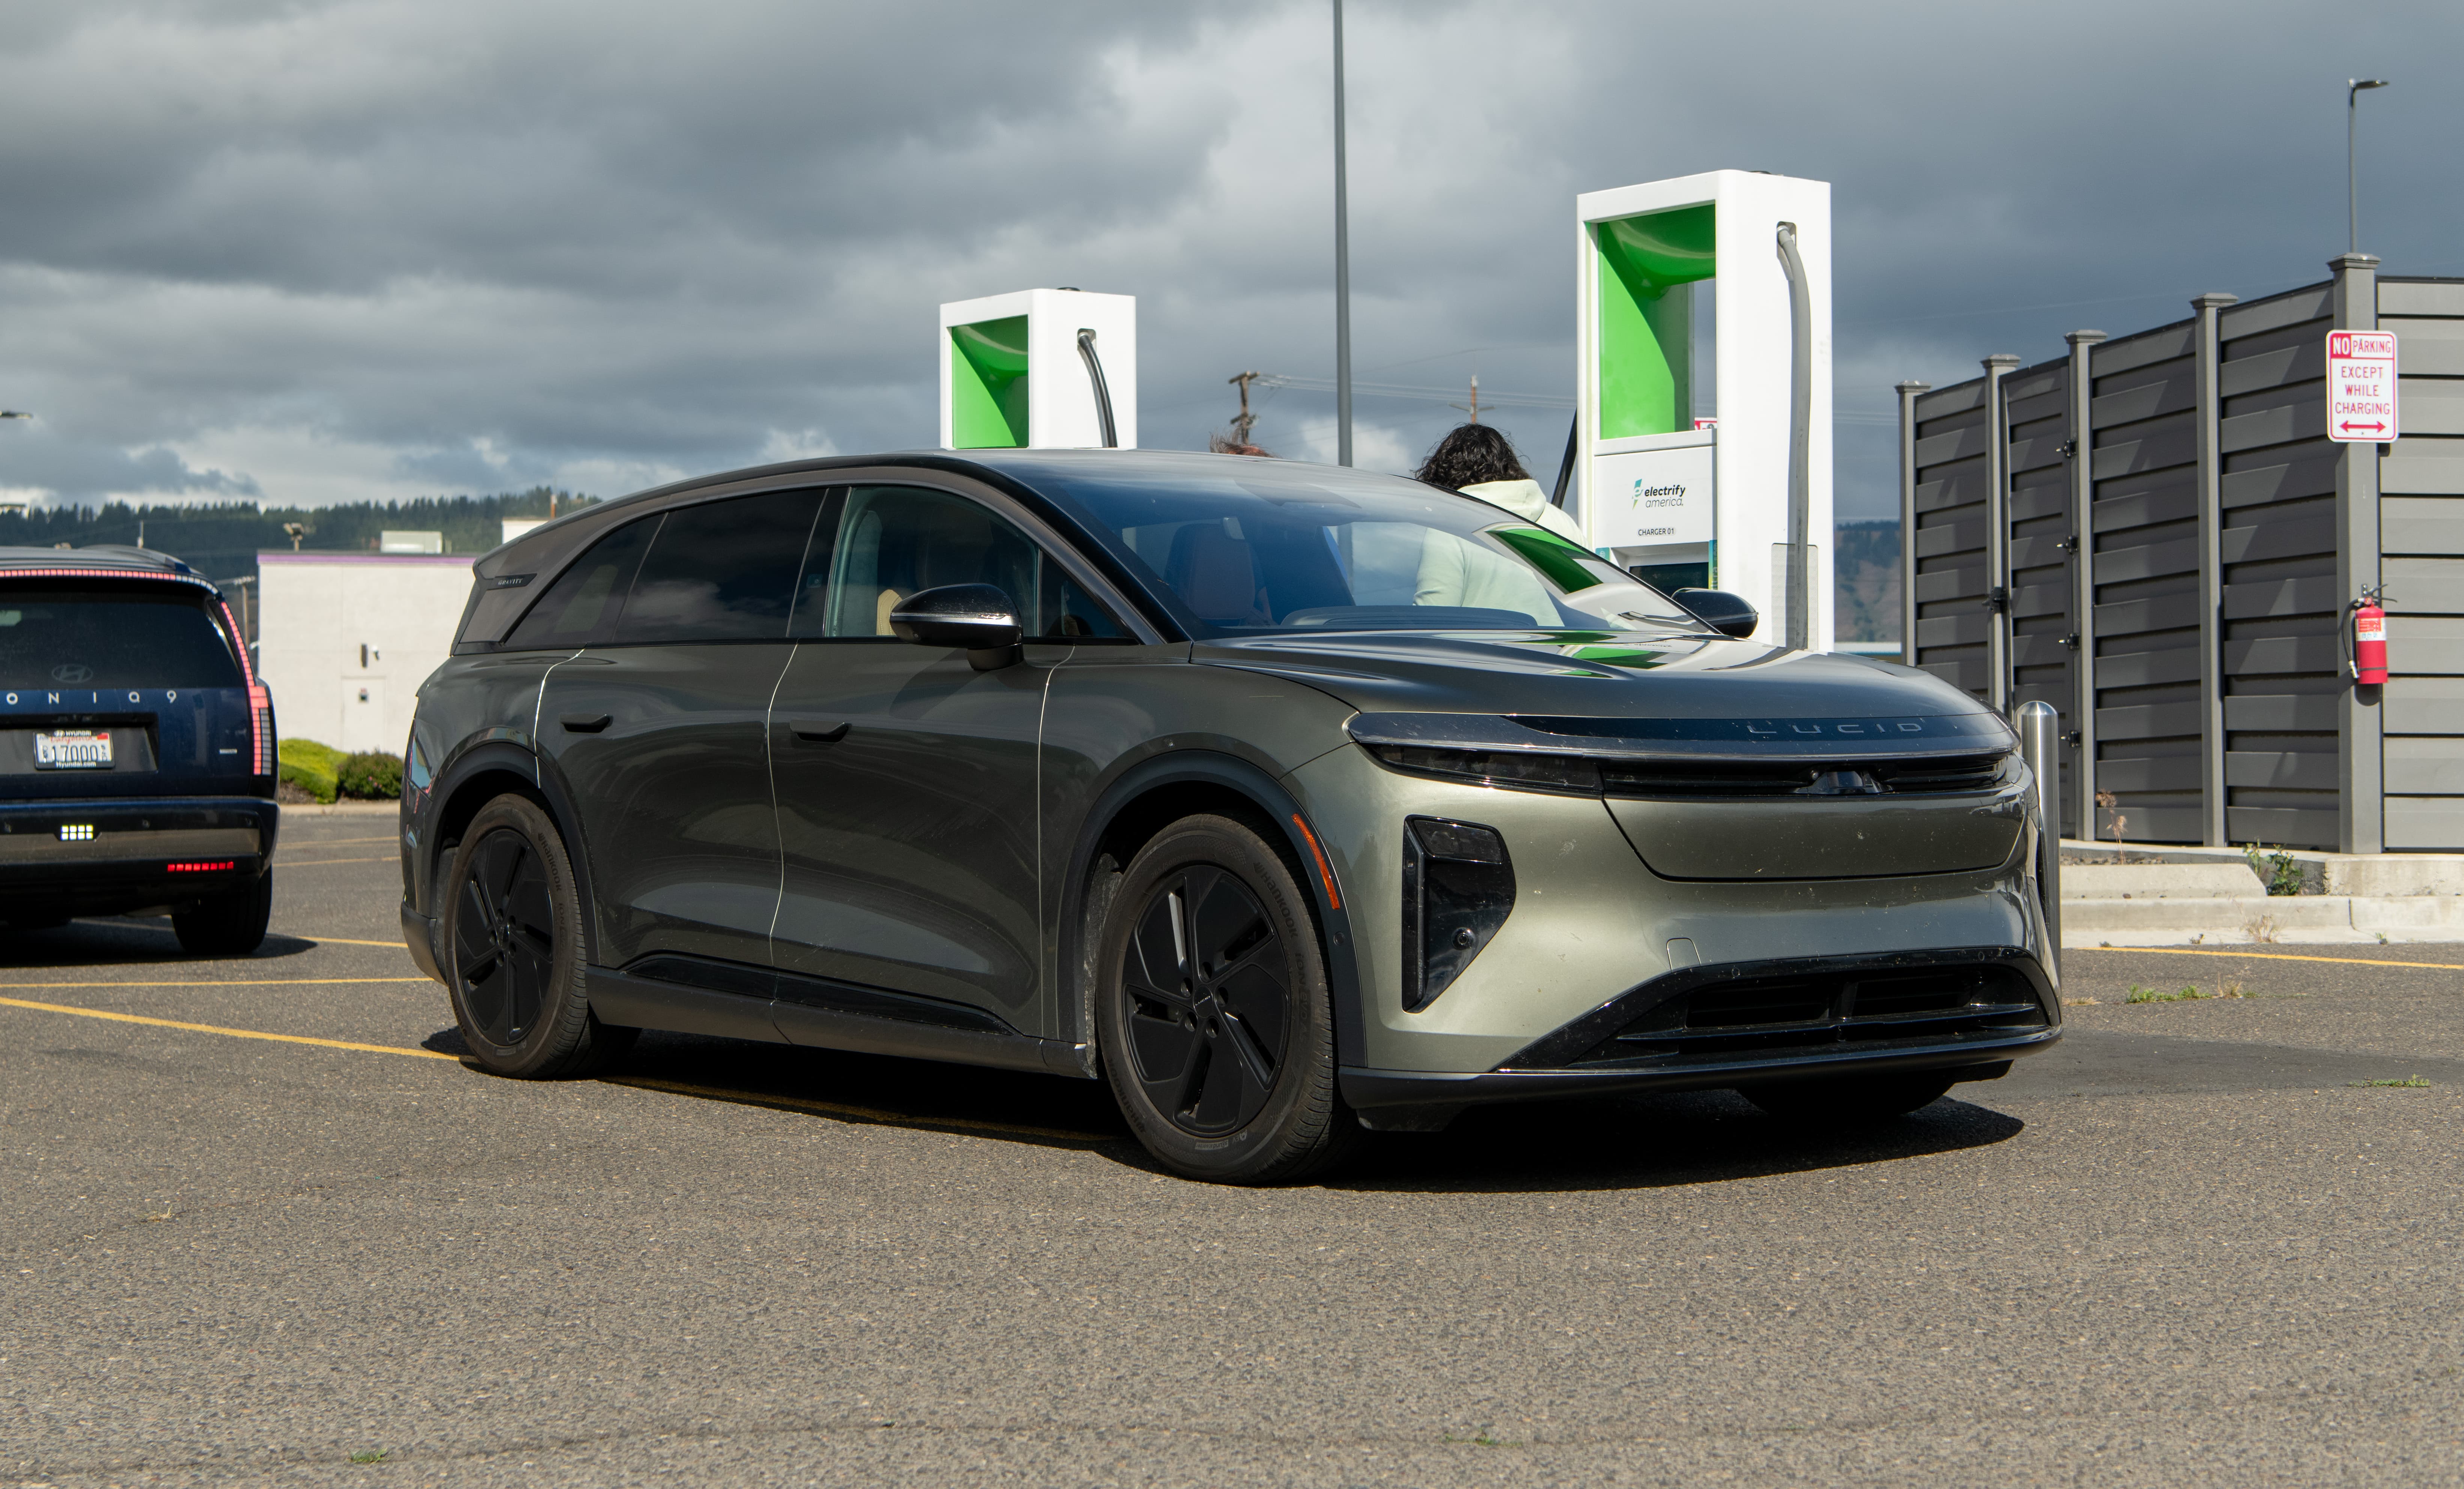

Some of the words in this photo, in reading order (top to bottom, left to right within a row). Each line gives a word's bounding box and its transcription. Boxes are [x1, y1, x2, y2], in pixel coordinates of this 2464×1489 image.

[2333, 337, 2350, 355] NO
[2353, 341, 2391, 353] PARKING
[2341, 366, 2383, 379] EXCEPT
[2345, 384, 2379, 396] WHILE
[2335, 402, 2390, 415] CHARGING
[1645, 485, 1685, 497] electrify
[1746, 723, 1922, 734] LUCID
[52, 745, 98, 762] 17000
[1195, 996, 1211, 1006] LUCID
